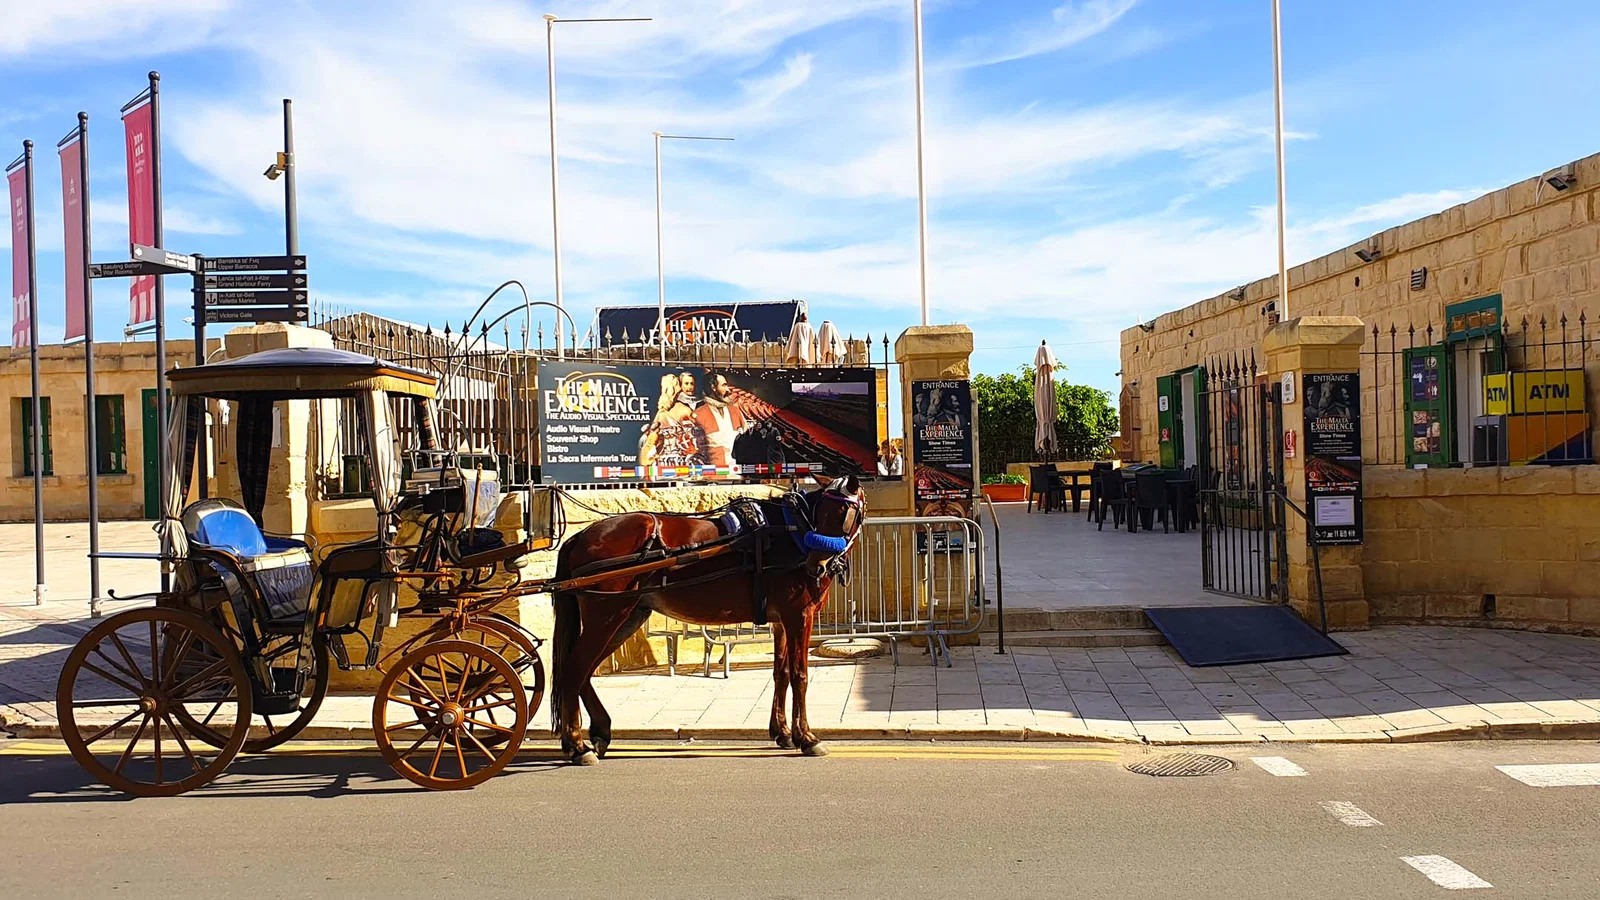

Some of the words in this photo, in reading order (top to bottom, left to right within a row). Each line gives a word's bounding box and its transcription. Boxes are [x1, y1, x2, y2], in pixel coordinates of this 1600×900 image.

[691, 316, 739, 331] MALTA
[1313, 375, 1350, 383] ENTRANCE
[554, 377, 583, 396] THE
[587, 379, 637, 396] MALTA
[1487, 387, 1507, 402] ATM
[1529, 384, 1570, 400] ATM
[544, 390, 650, 414] EXPERIENCE
[545, 412, 559, 420] THE
[559, 412, 582, 420] AUDIO
[583, 412, 605, 421] VISUAL
[606, 412, 650, 421] SPECTACULAR
[546, 425, 568, 433] Audio
[568, 425, 591, 433] Visual
[592, 425, 621, 433] Theatre
[1311, 422, 1354, 430] EXPERIENCE
[920, 429, 964, 438] EXPERIENCE
[546, 435, 579, 443] Souvenir
[579, 435, 599, 445] Shop
[547, 445, 569, 453] Bistro
[547, 455, 557, 463] La
[558, 455, 580, 463] Sacra
[580, 454, 619, 462] Infermeria
[620, 454, 637, 462] Tour
